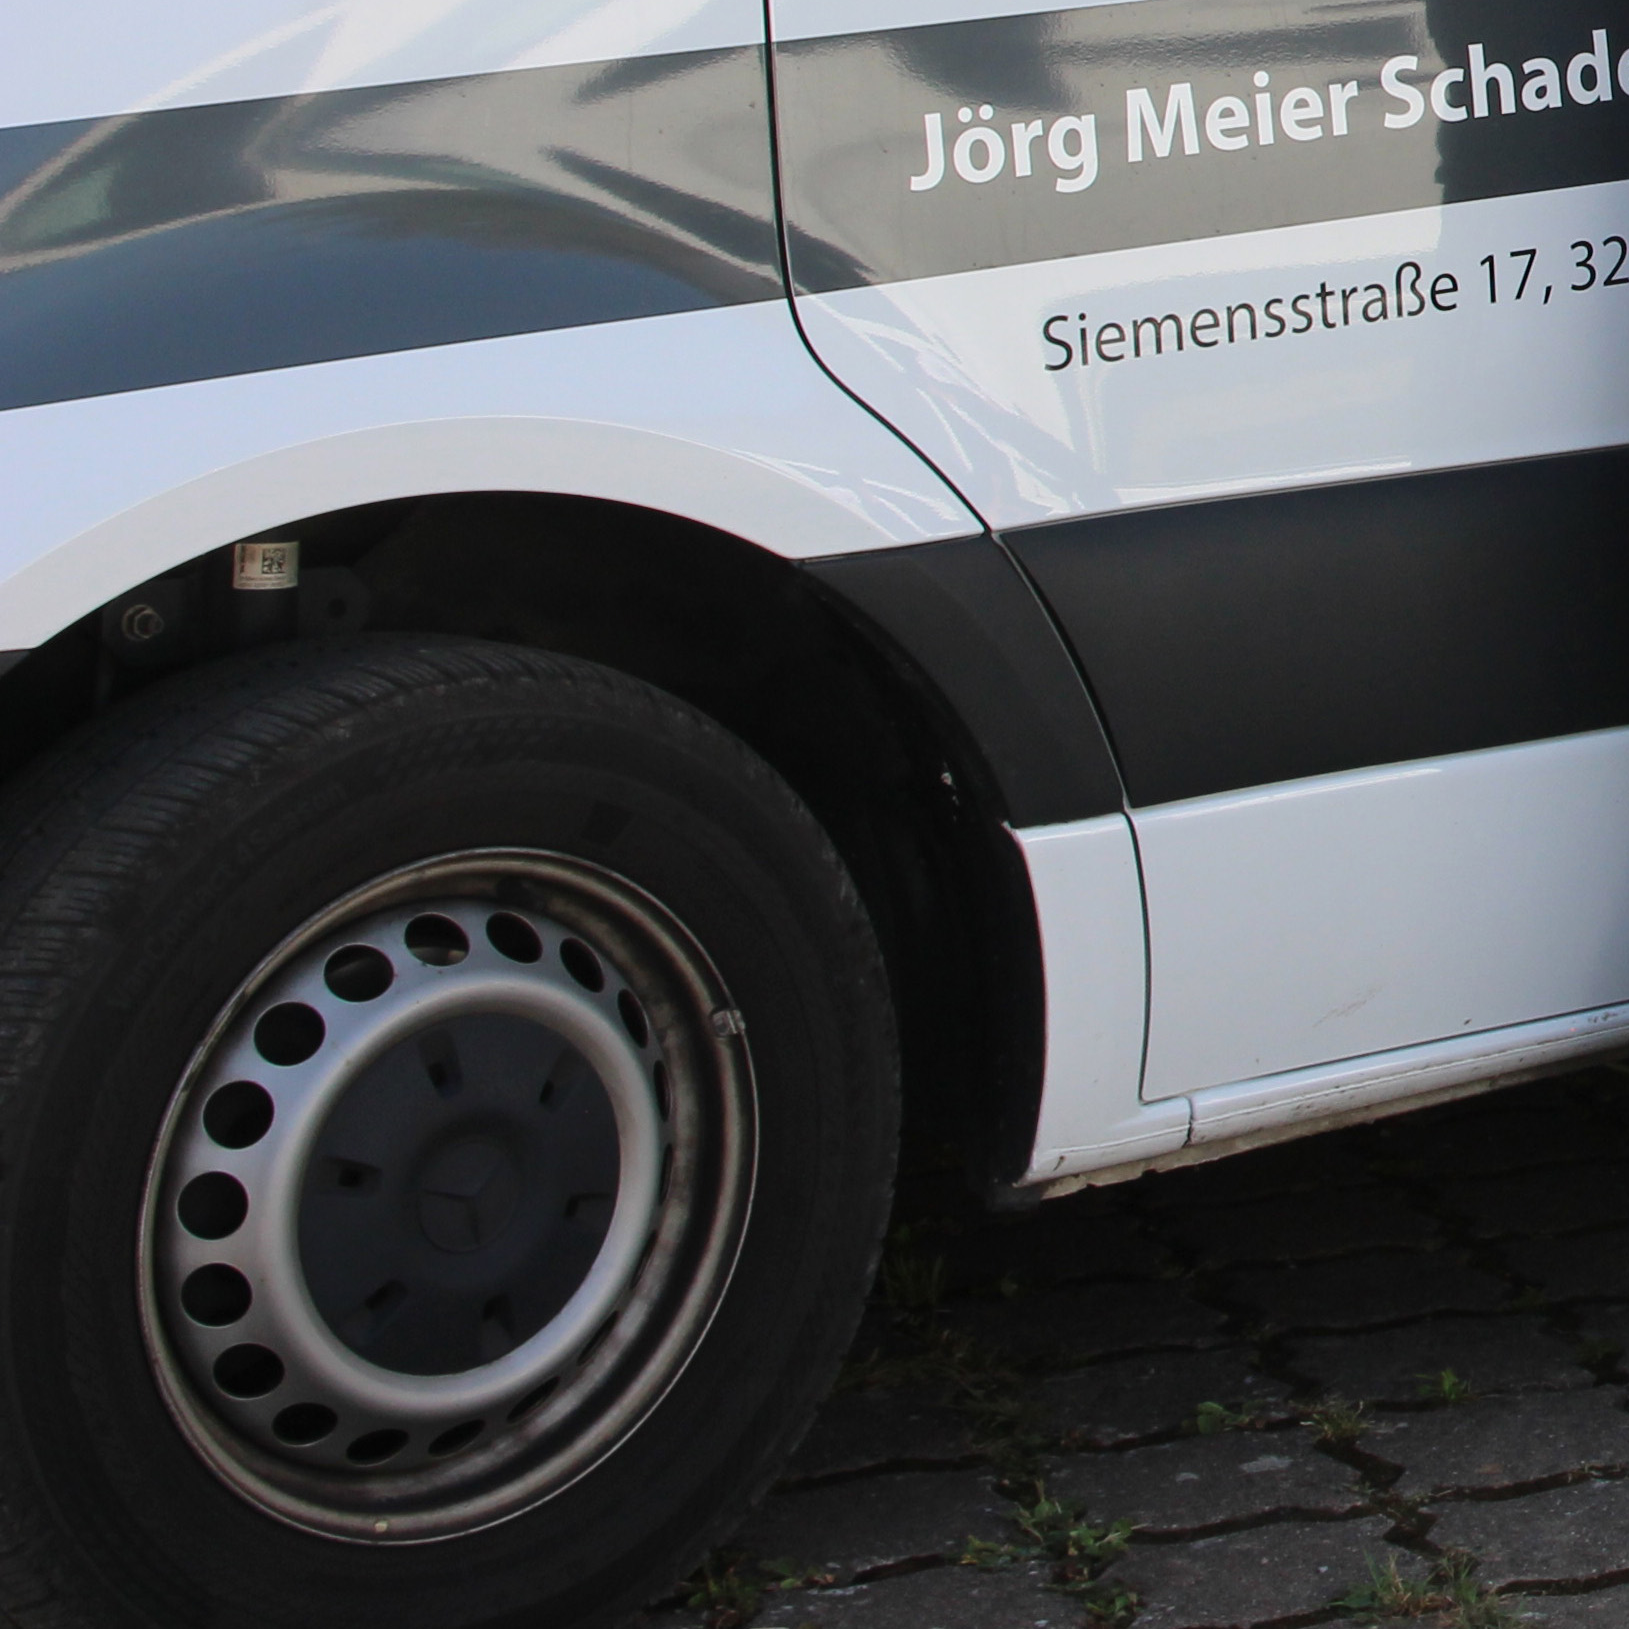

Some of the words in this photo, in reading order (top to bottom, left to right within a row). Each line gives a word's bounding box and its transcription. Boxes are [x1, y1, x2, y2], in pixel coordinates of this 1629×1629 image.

[909, 106, 1098, 194] Jörg
[1125, 71, 1360, 165] Meier
[1042, 261, 1459, 372] Siemensstraße
[1479, 248, 1553, 308] 17,
